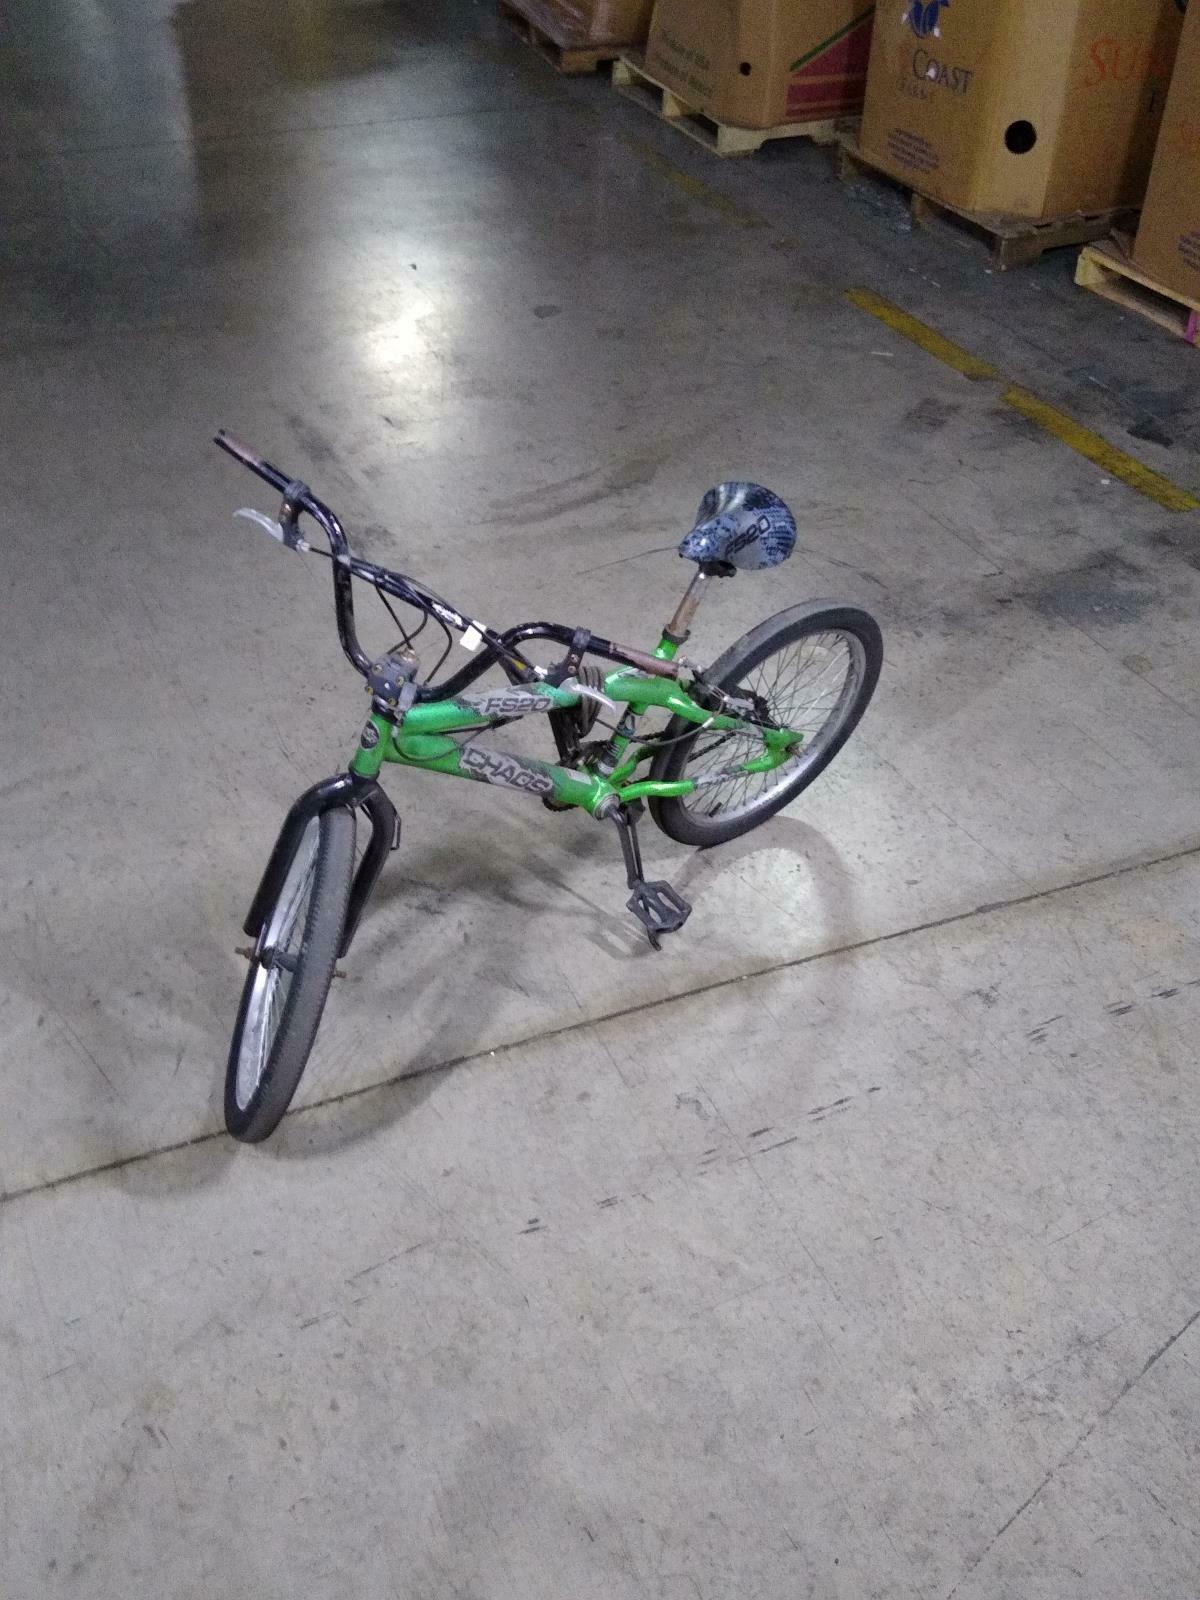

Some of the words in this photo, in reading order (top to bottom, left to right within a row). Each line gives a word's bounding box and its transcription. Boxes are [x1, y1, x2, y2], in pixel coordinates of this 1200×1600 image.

[913, 48, 973, 96] COAST
[484, 697, 552, 713] FS20
[462, 747, 550, 793] CHAOS
